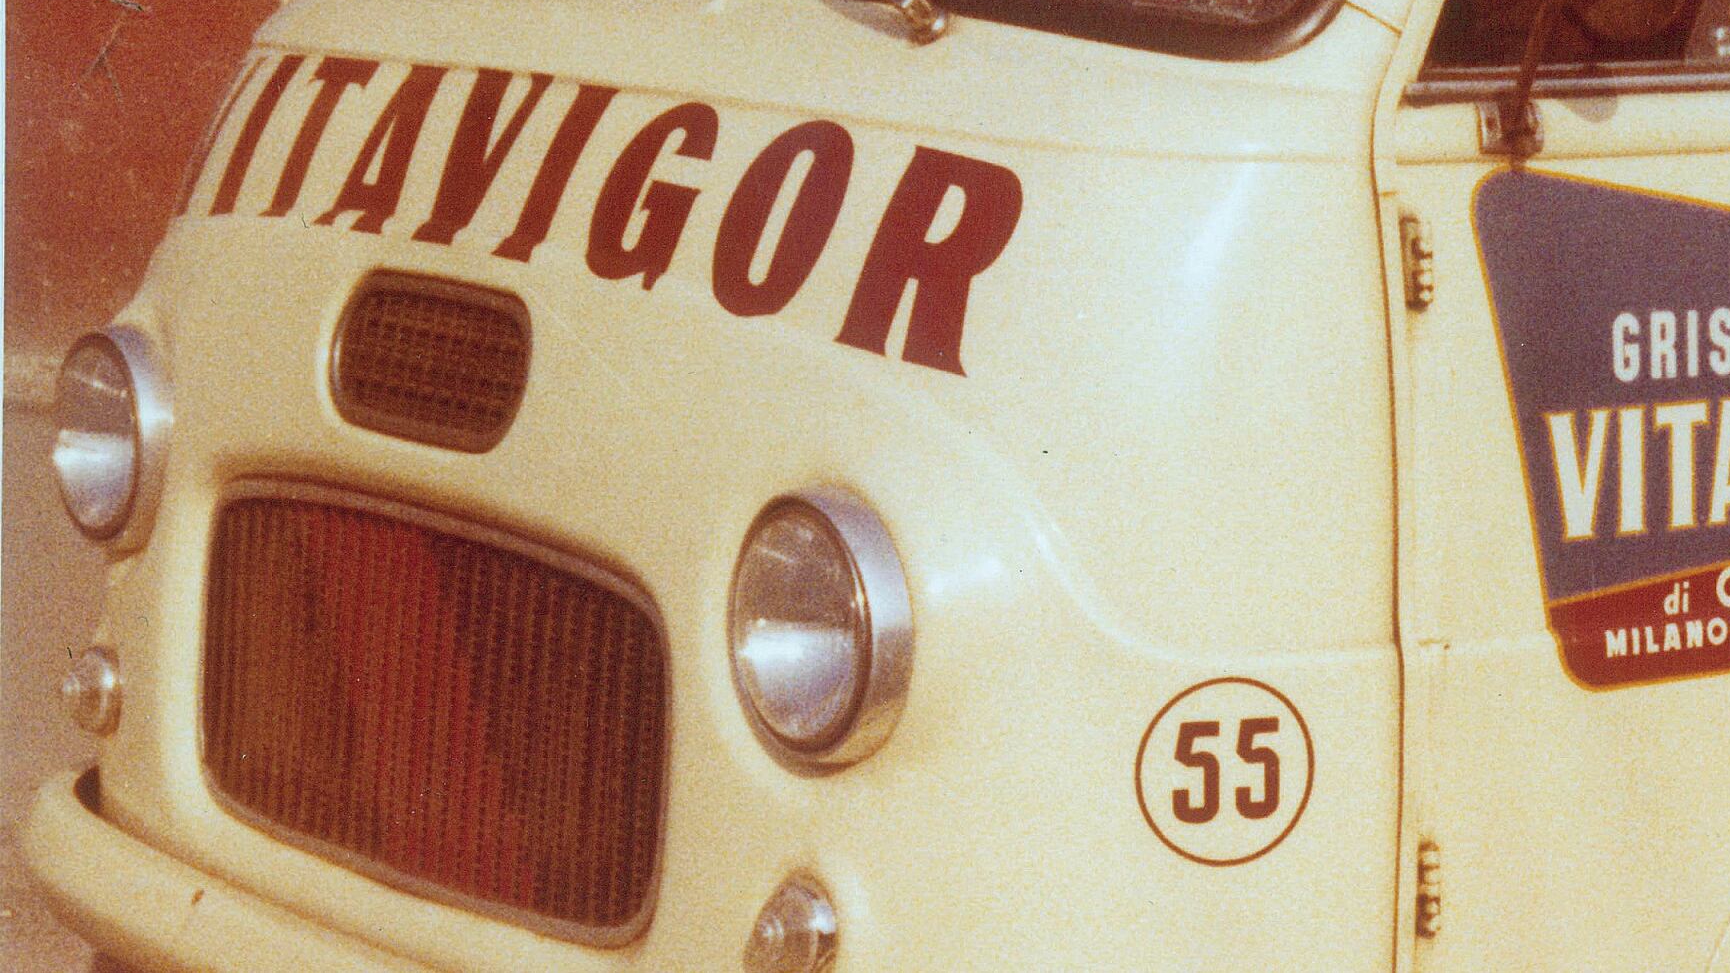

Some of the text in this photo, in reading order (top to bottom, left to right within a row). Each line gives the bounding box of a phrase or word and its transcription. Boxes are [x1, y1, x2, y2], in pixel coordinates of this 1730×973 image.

[172, 53, 1024, 378] ITAVIGOR
[1662, 580, 1690, 616] di
[1171, 715, 1281, 825] 55
